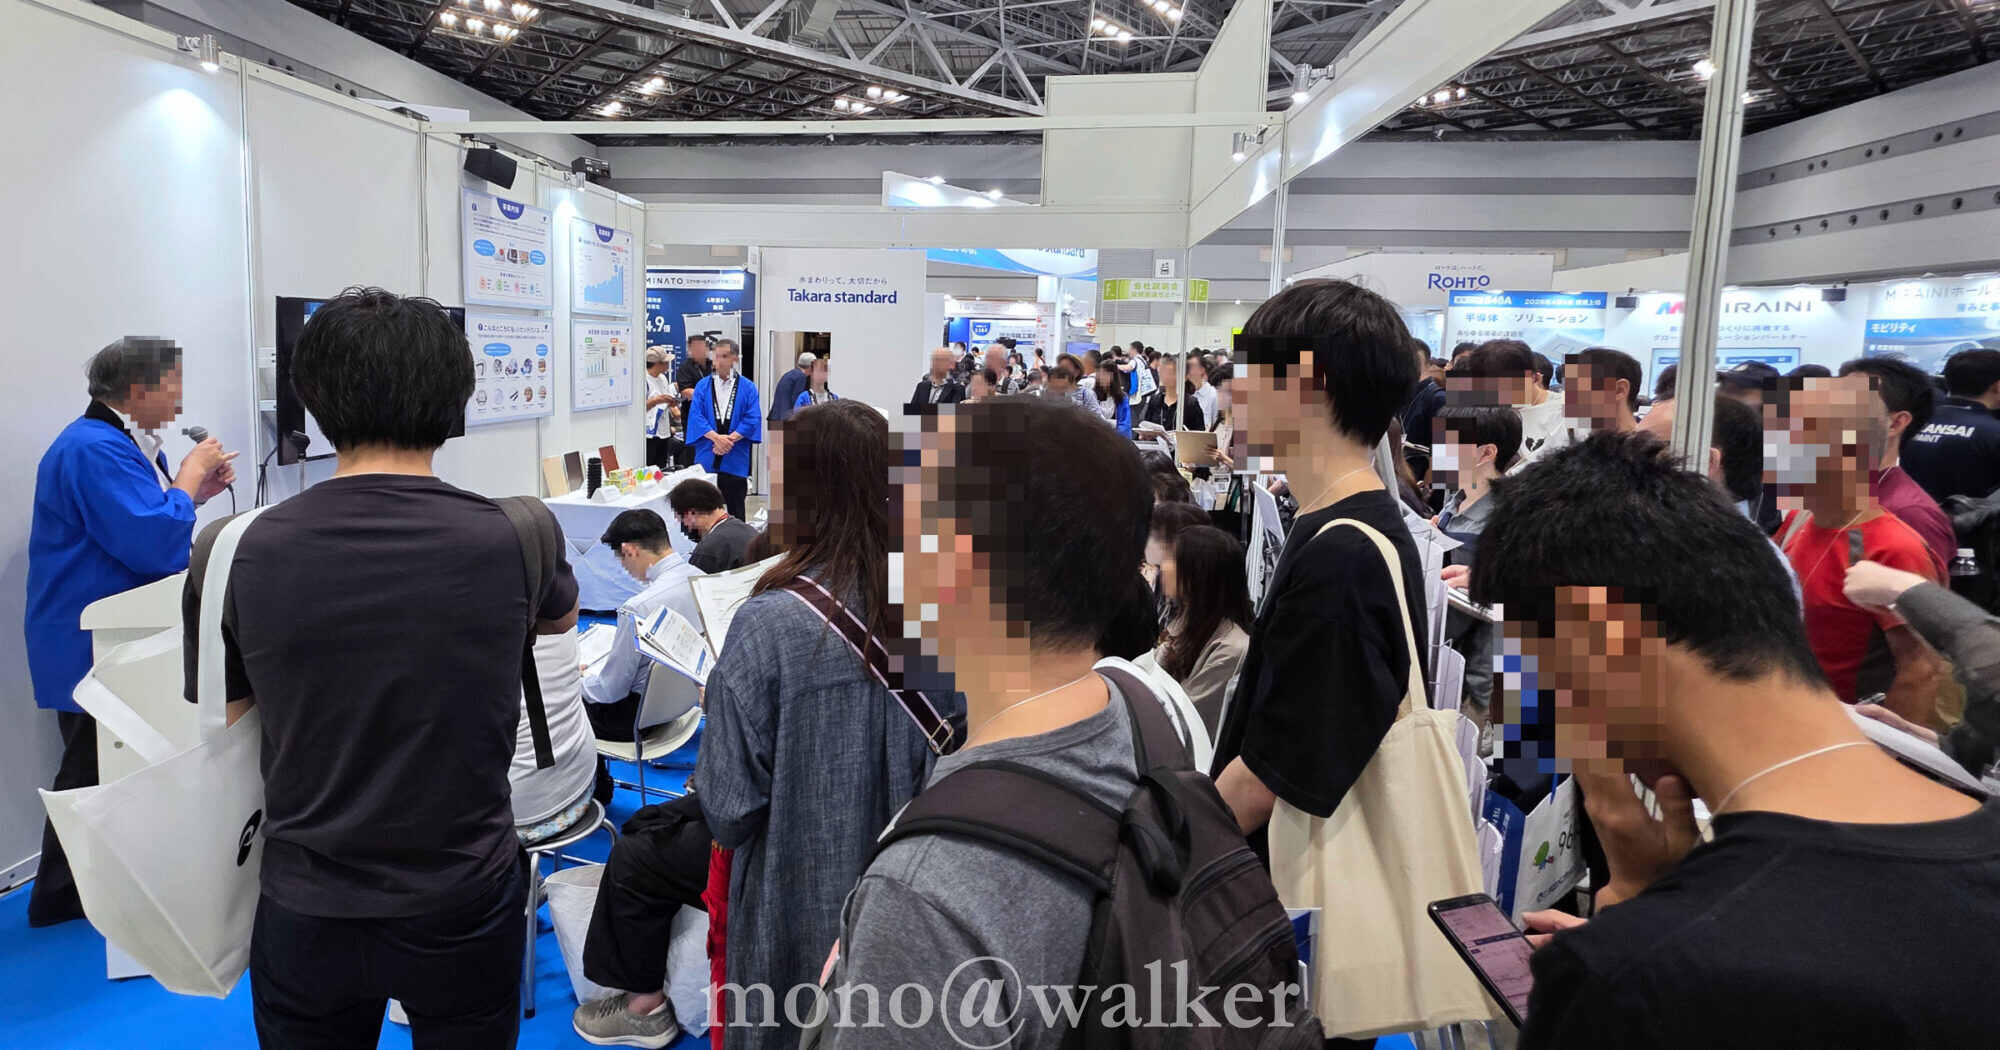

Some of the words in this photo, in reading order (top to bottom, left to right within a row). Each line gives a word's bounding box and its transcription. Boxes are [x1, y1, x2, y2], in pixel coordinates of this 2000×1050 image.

[1428, 273, 1490, 290] ROHTO
[787, 288, 832, 302] Takara
[834, 289, 898, 304] standard
[1724, 301, 1812, 313] IRAINI
[1514, 313, 1589, 324] ソリューション
[1870, 322, 1917, 334] モビリティ
[1921, 423, 1975, 438] ANSAI
